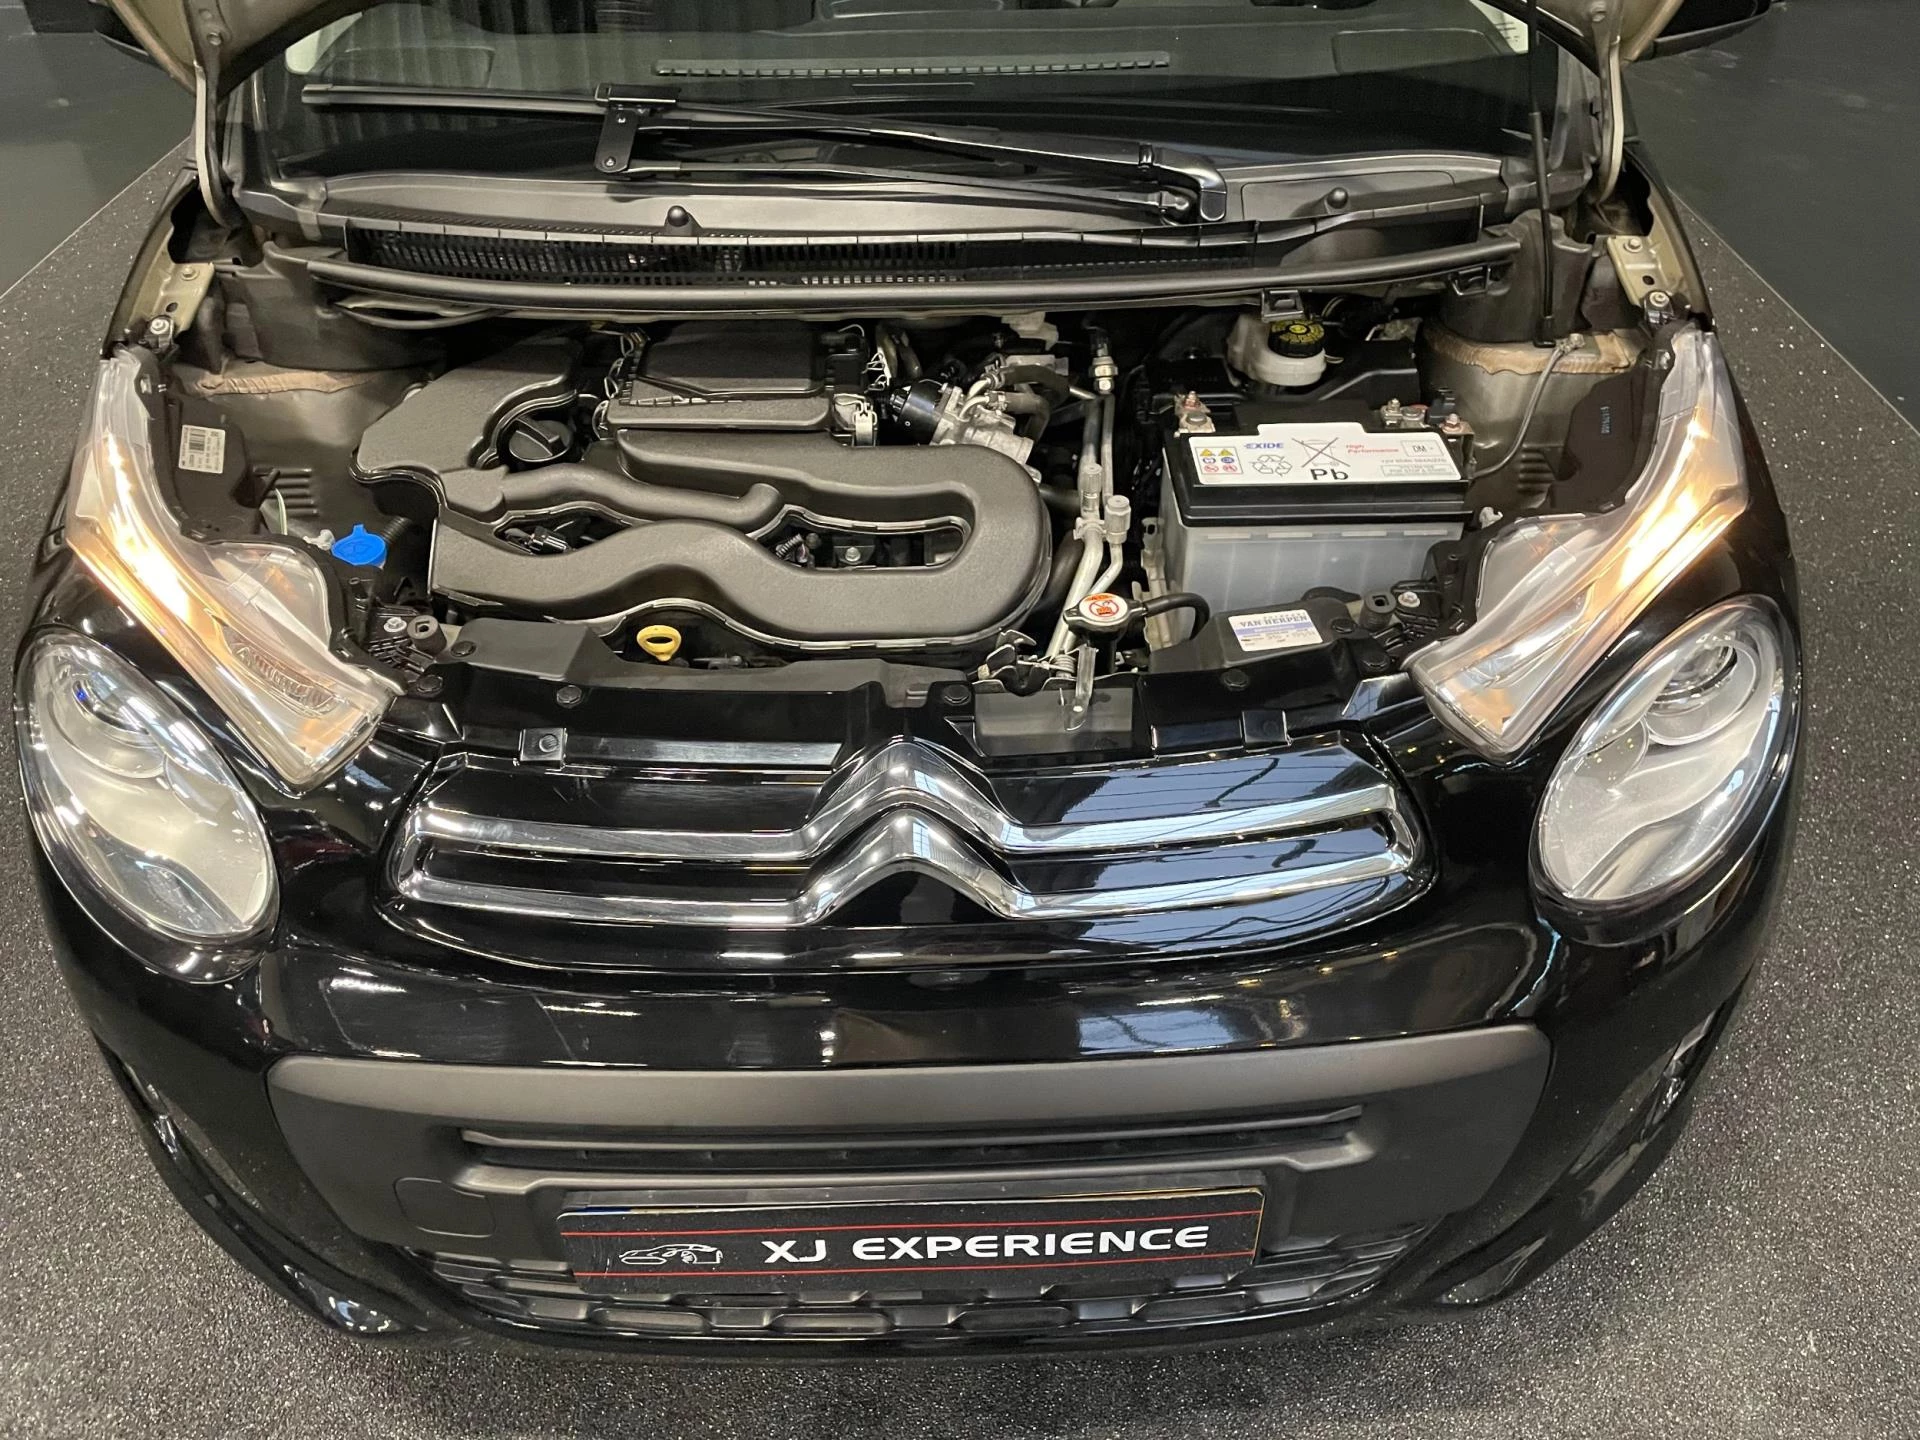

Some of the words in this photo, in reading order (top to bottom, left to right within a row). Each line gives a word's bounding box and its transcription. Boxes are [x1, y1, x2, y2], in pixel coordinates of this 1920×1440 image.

[1310, 468, 1349, 480] Pb
[762, 1240, 826, 1263] XJ
[852, 1226, 1210, 1261] EXPERIENCE
